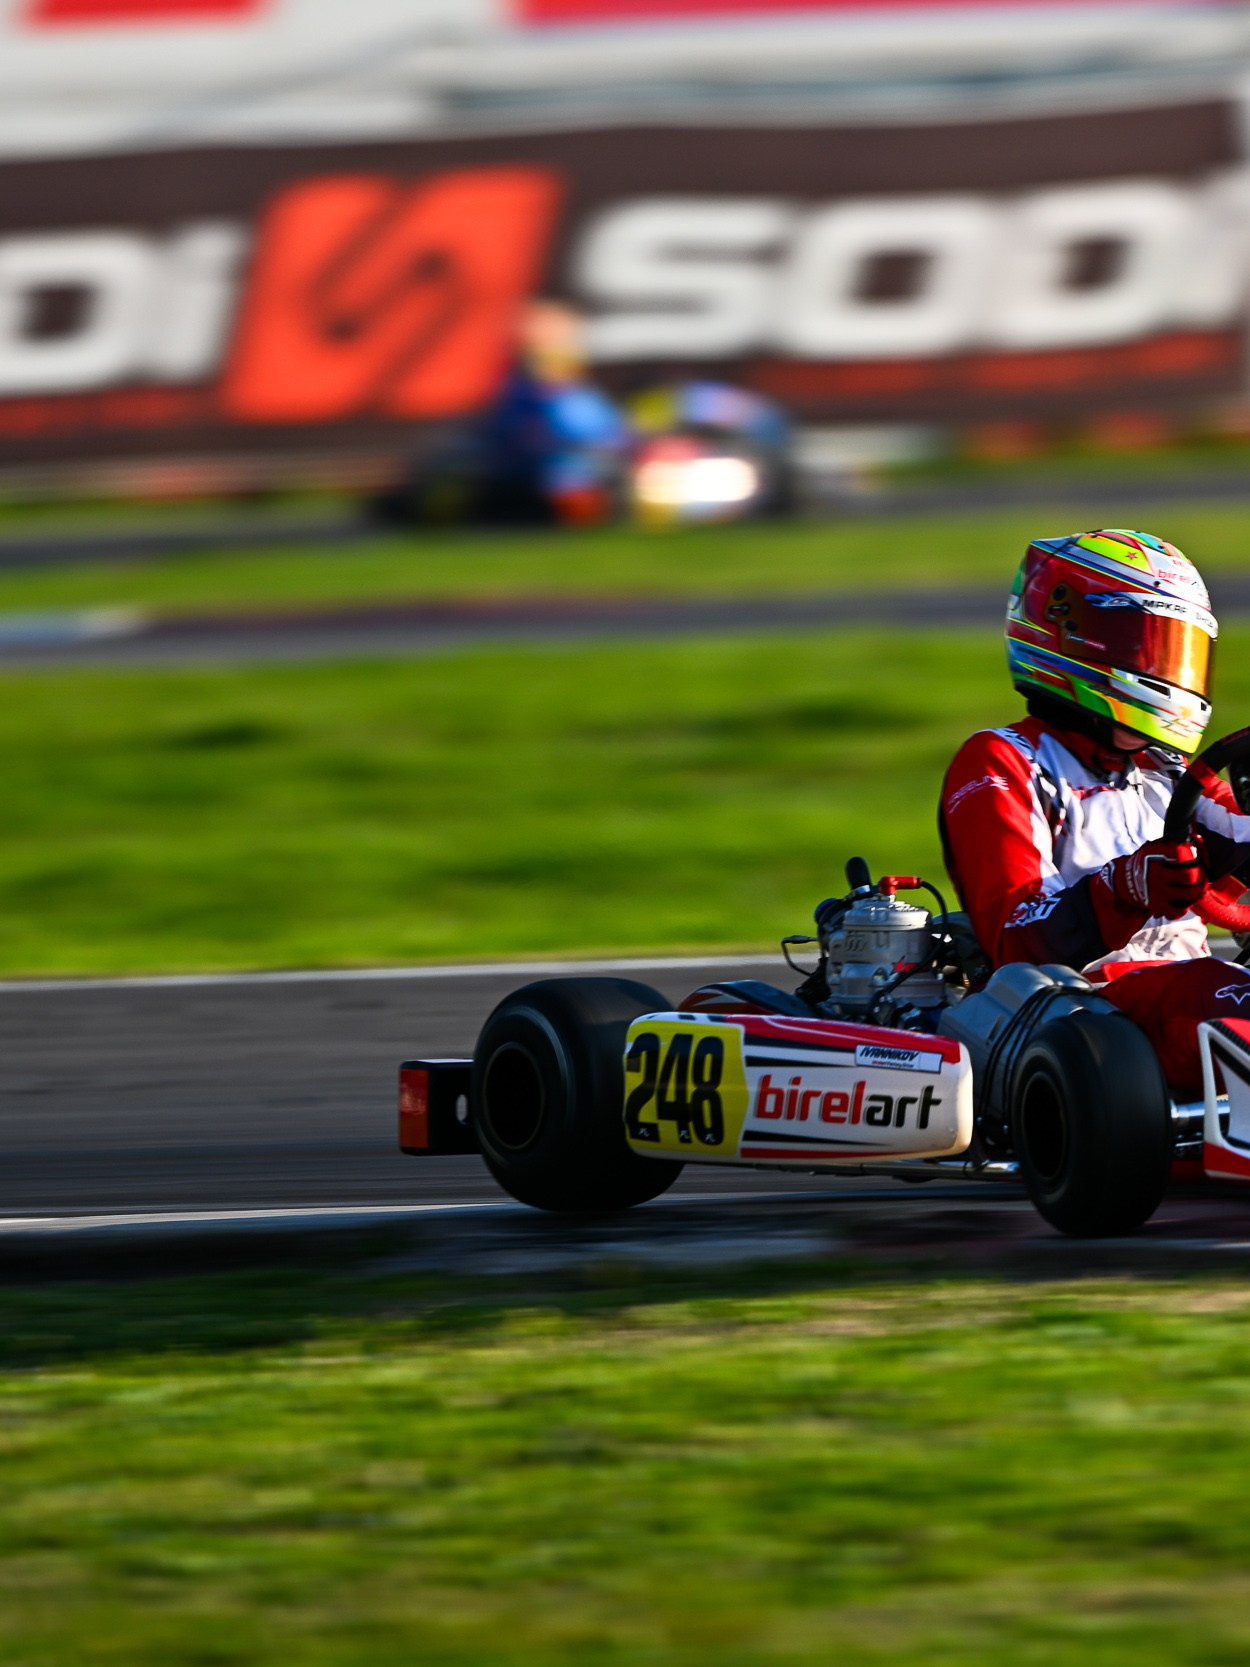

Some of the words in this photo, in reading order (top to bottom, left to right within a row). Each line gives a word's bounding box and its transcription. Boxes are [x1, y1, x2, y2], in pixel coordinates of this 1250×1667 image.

[860, 1046, 919, 1062] IVANNIKOV
[625, 1032, 724, 1146] 248
[755, 1074, 941, 1129] birelart
